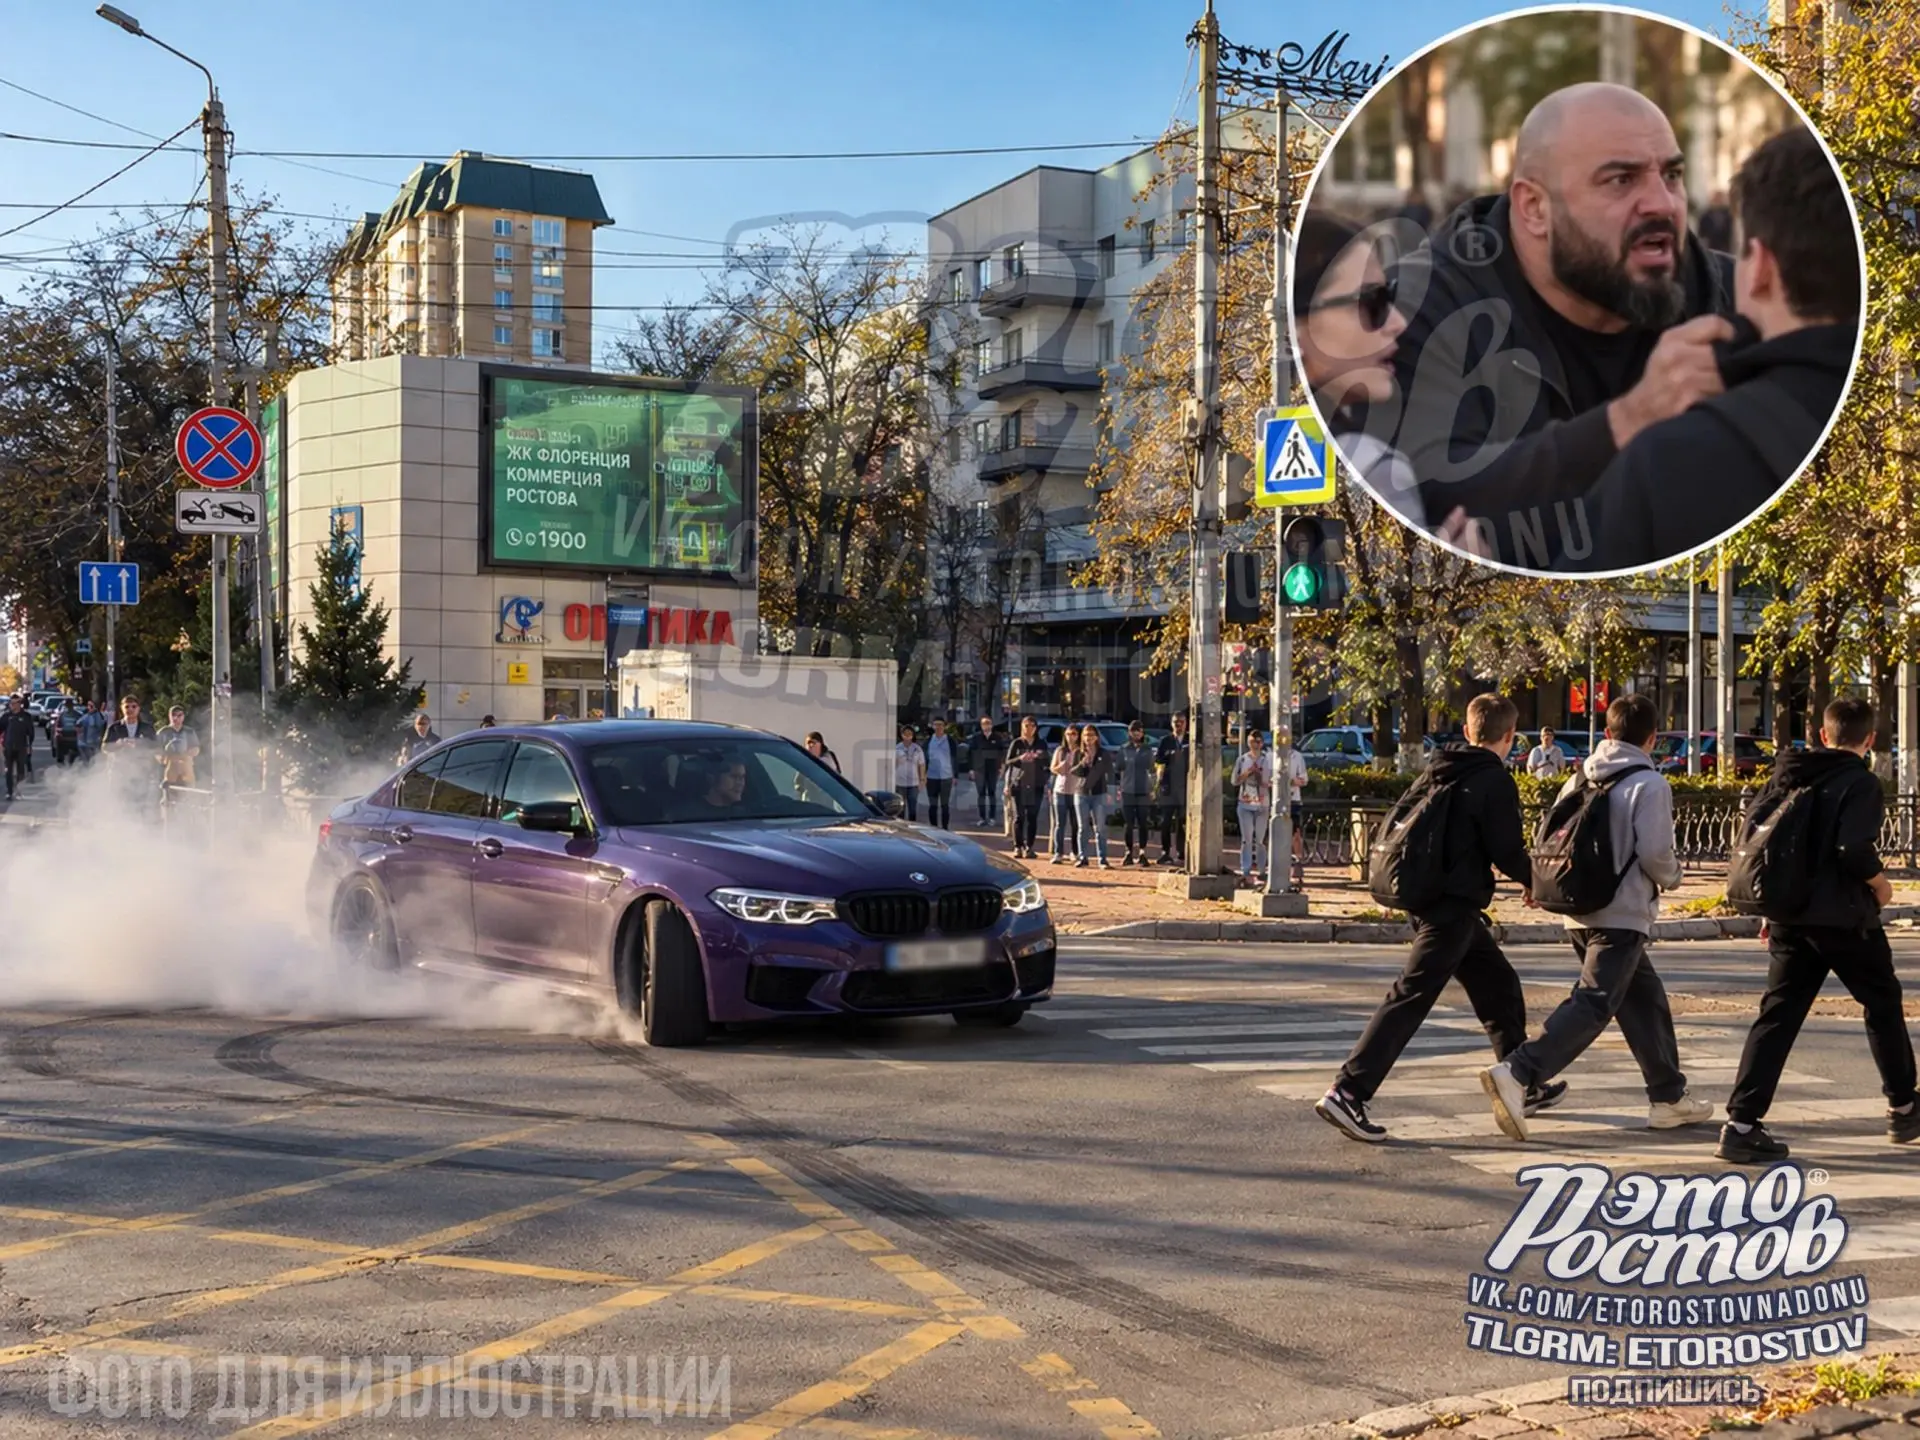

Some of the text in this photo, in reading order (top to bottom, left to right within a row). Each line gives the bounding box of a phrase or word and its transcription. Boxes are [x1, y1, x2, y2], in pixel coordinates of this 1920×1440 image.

[1277, 29, 1394, 85] Mari
[506, 446, 631, 470] ЖК ФЛОРЕНЦИЯ
[506, 468, 602, 487] КОММЕРЦИЯ
[506, 488, 578, 507] РОСТОВА
[539, 529, 587, 550] 1900
